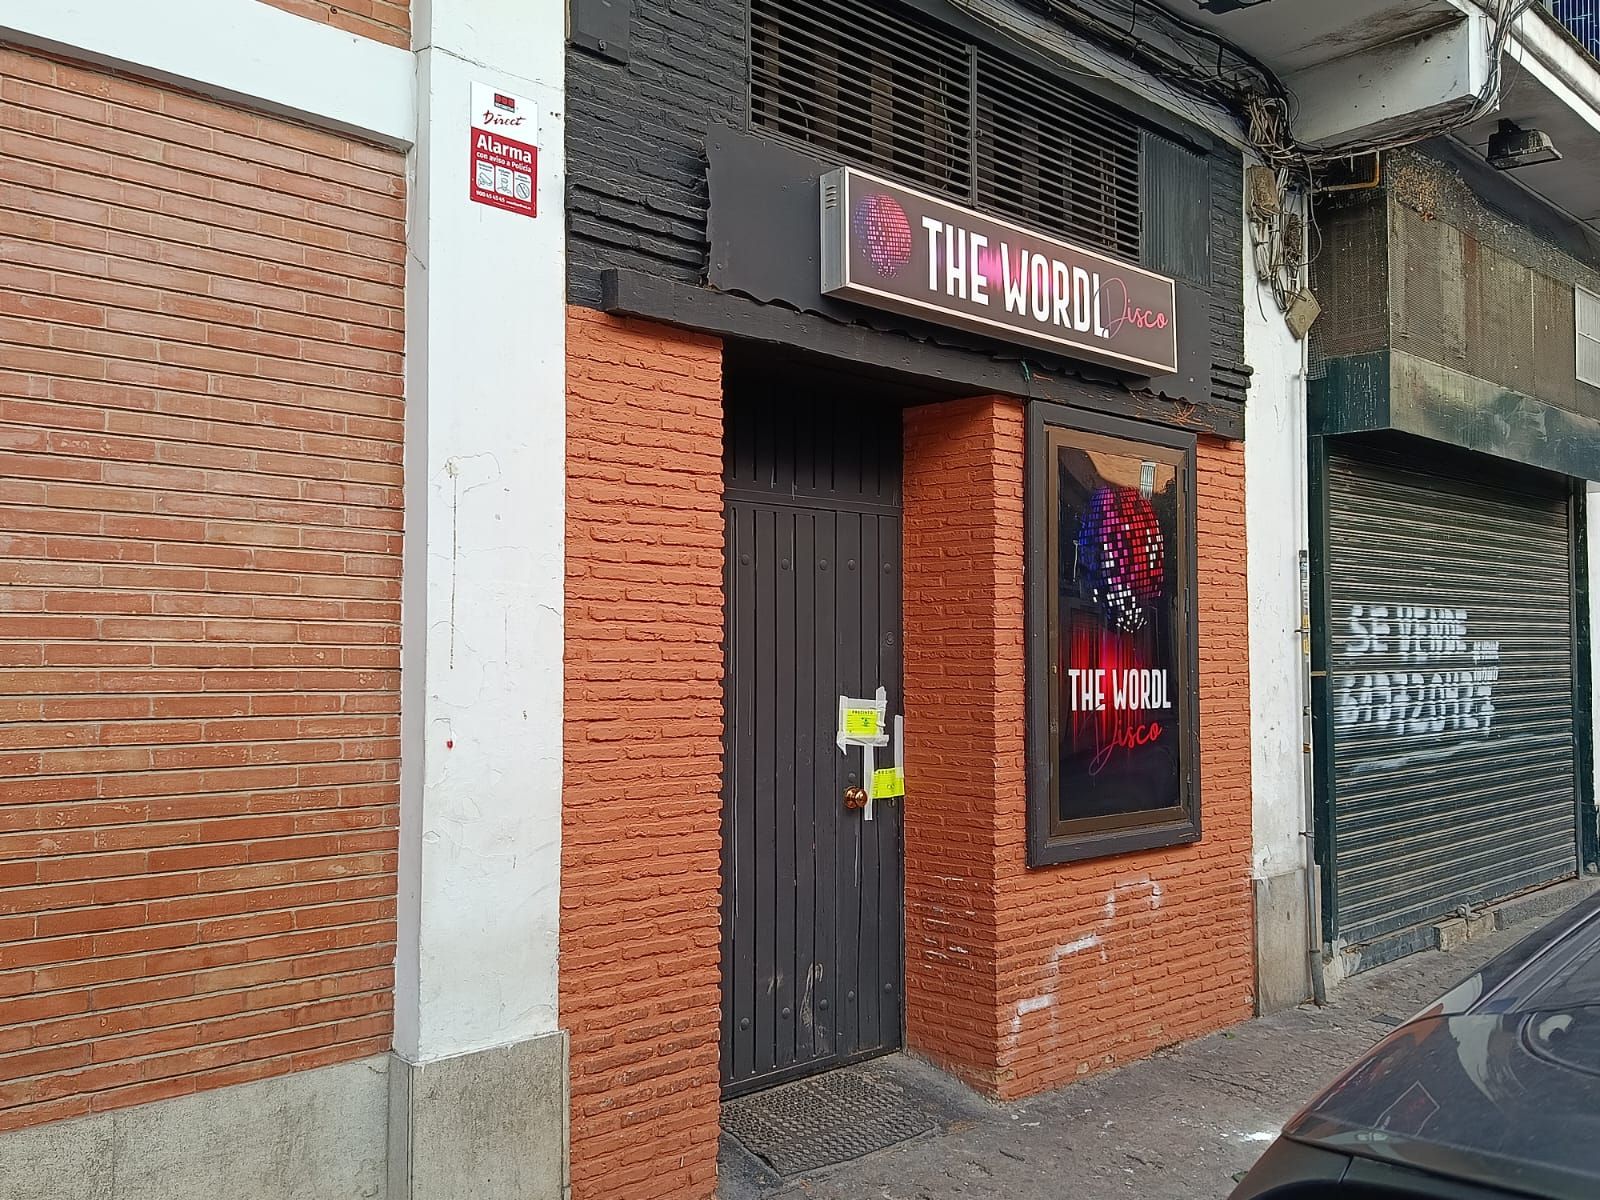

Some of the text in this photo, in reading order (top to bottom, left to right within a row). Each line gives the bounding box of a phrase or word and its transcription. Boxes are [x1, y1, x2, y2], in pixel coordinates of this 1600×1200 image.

[483, 109, 526, 126] Direct
[476, 133, 532, 164] Alarma
[476, 151, 488, 160] con
[489, 154, 505, 165] aviso
[921, 215, 1109, 339] THE WORDL
[1094, 277, 1168, 340] Disco
[1346, 605, 1390, 656] SE
[1396, 607, 1468, 660] VENDE
[1068, 668, 1171, 711] THE WORDL
[1080, 708, 1163, 775] Disco
